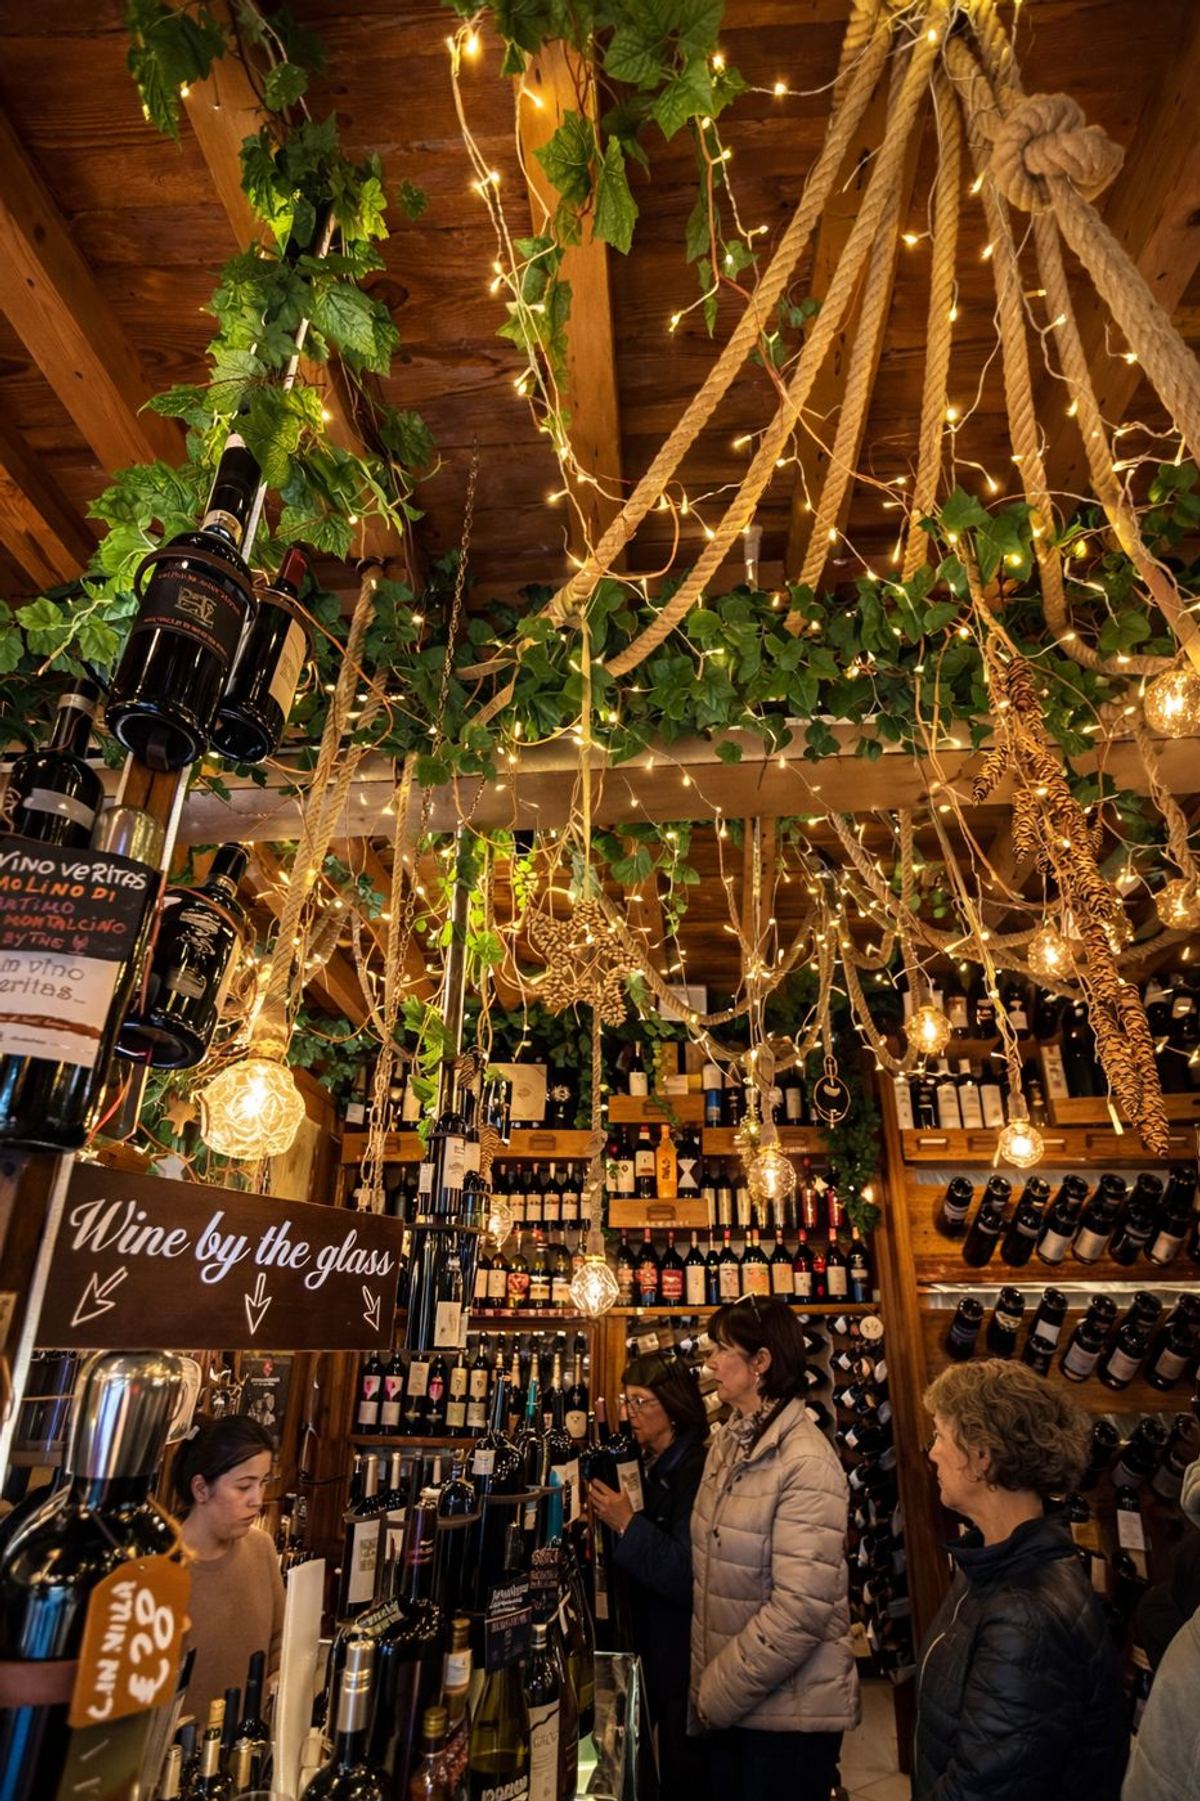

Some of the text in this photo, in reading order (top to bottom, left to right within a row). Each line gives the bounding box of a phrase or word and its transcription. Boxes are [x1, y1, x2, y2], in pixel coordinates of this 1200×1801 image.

[69, 1198, 394, 1290] Wine by the glass
